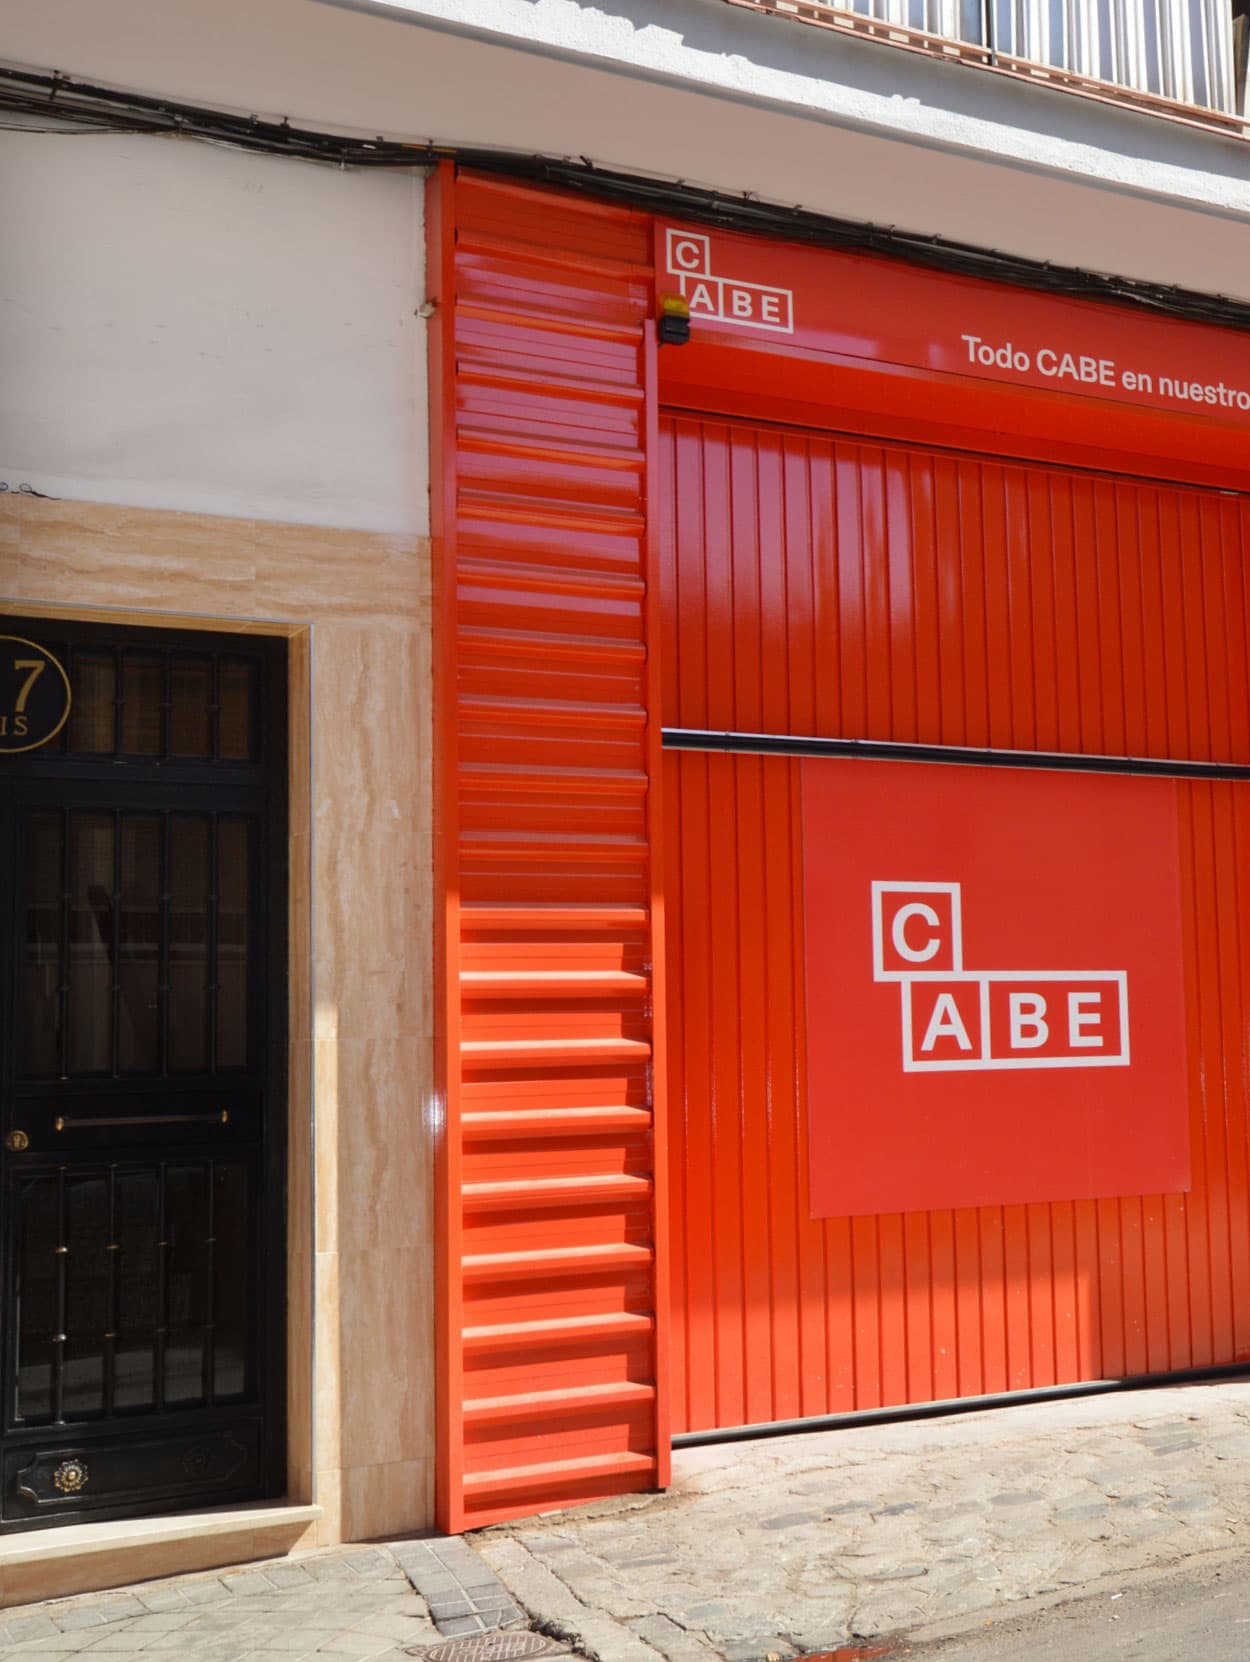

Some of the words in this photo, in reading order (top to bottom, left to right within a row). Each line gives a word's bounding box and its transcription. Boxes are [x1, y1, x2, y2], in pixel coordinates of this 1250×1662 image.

[961, 334, 1030, 372] Todo
[1037, 349, 1116, 387] CABE
[1122, 370, 1152, 393] en
[14, 660, 46, 712] 7
